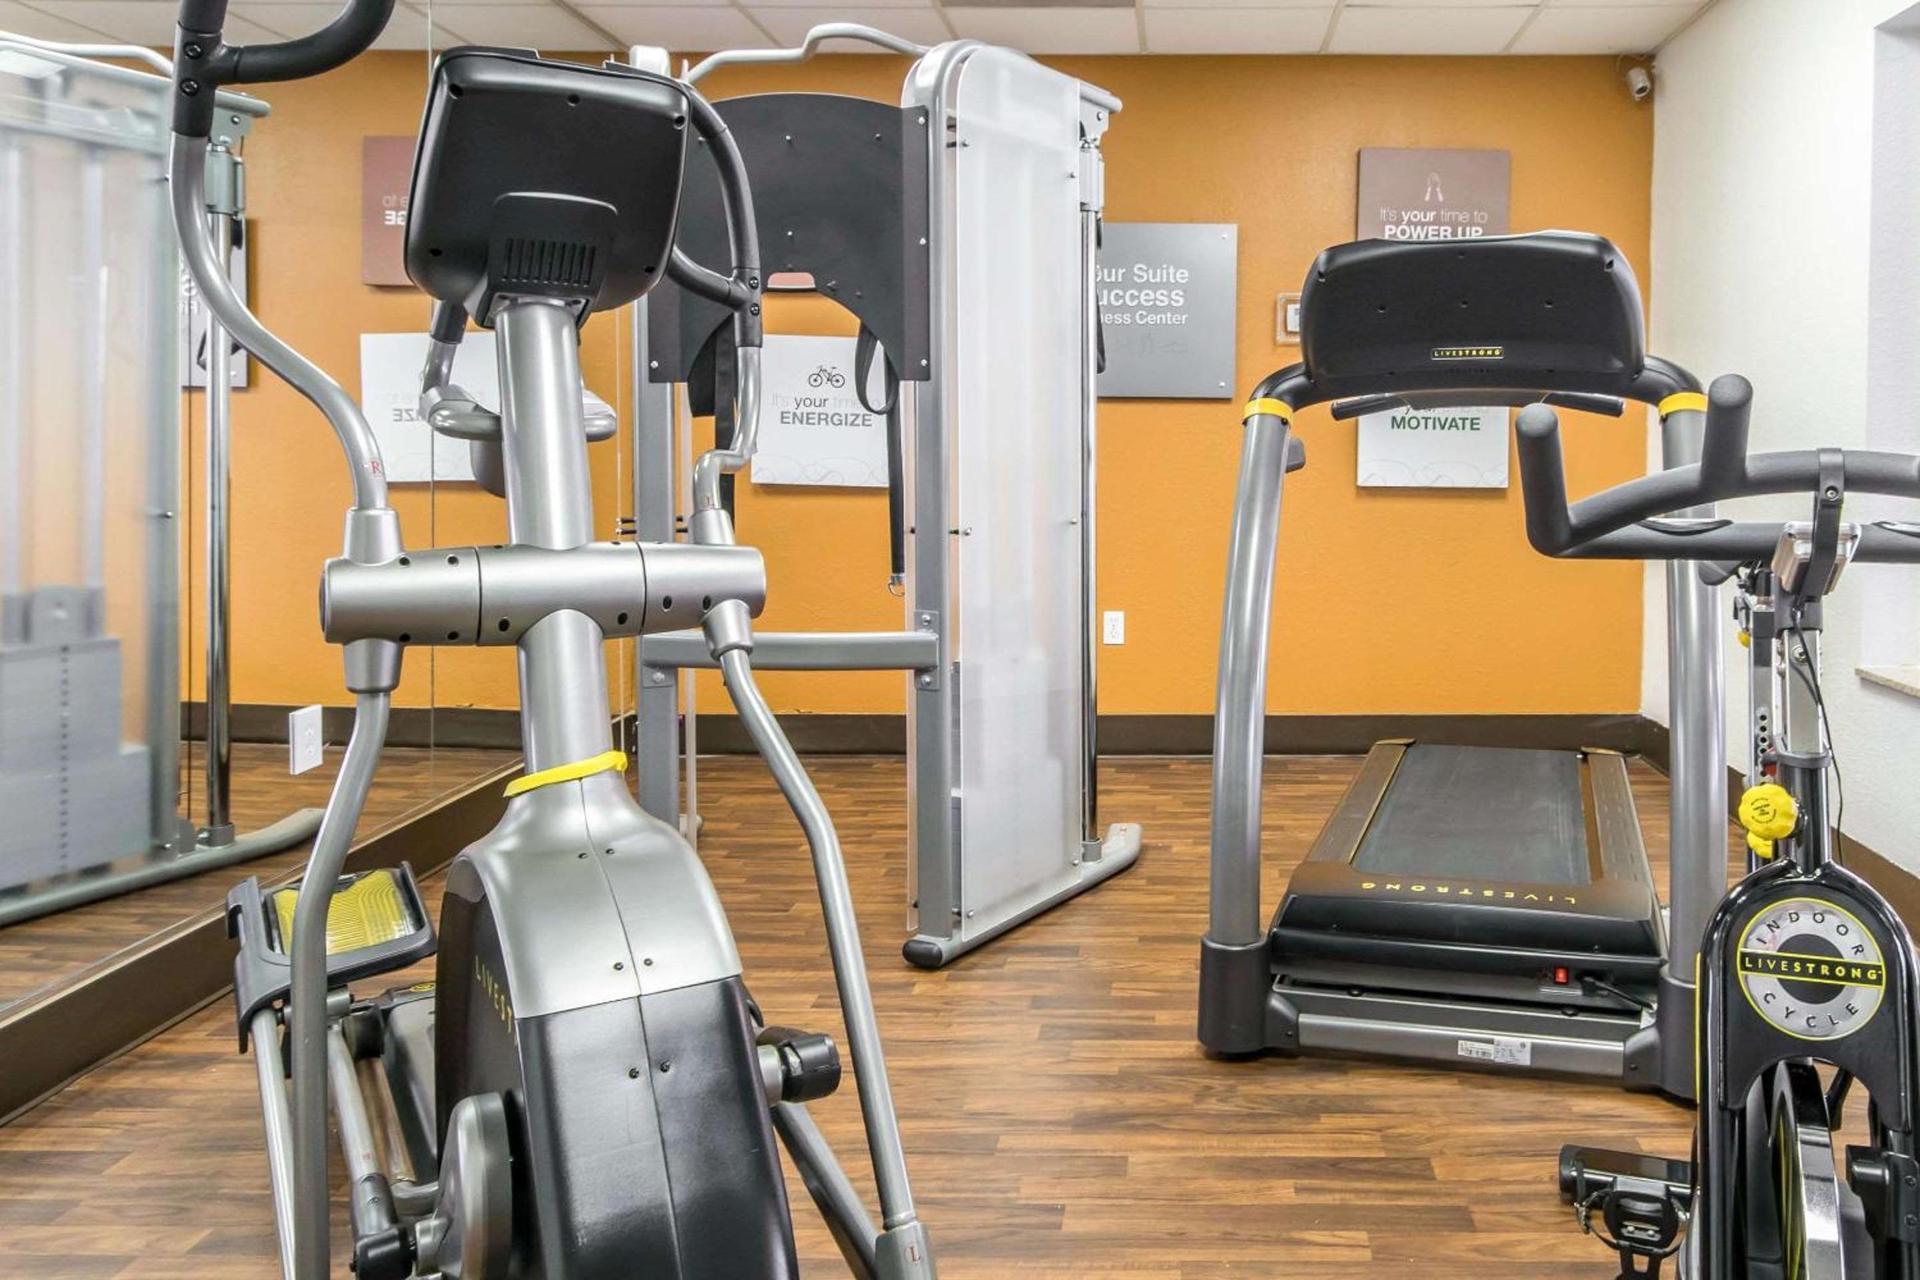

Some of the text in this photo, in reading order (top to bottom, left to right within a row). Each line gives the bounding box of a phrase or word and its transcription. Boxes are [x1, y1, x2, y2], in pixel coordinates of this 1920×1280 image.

[1401, 211, 1436, 225] your
[1440, 210, 1470, 223] time
[1474, 211, 1488, 223] to
[1384, 225, 1483, 240] POWER UP
[1133, 264, 1189, 283] Suite
[1097, 289, 1185, 306] uccess
[1135, 311, 1189, 325] Center
[1434, 349, 1501, 357] LIVESTRONG
[794, 396, 829, 410] your
[780, 411, 873, 427] ENERGIZE
[1391, 416, 1481, 431] MOTIVATE
[1361, 882, 1576, 905] LIVESTRONG
[1756, 911, 1865, 957] INDOOR
[1745, 957, 1877, 980] LIVESTRONG
[1763, 991, 1859, 1029] CYCLE
